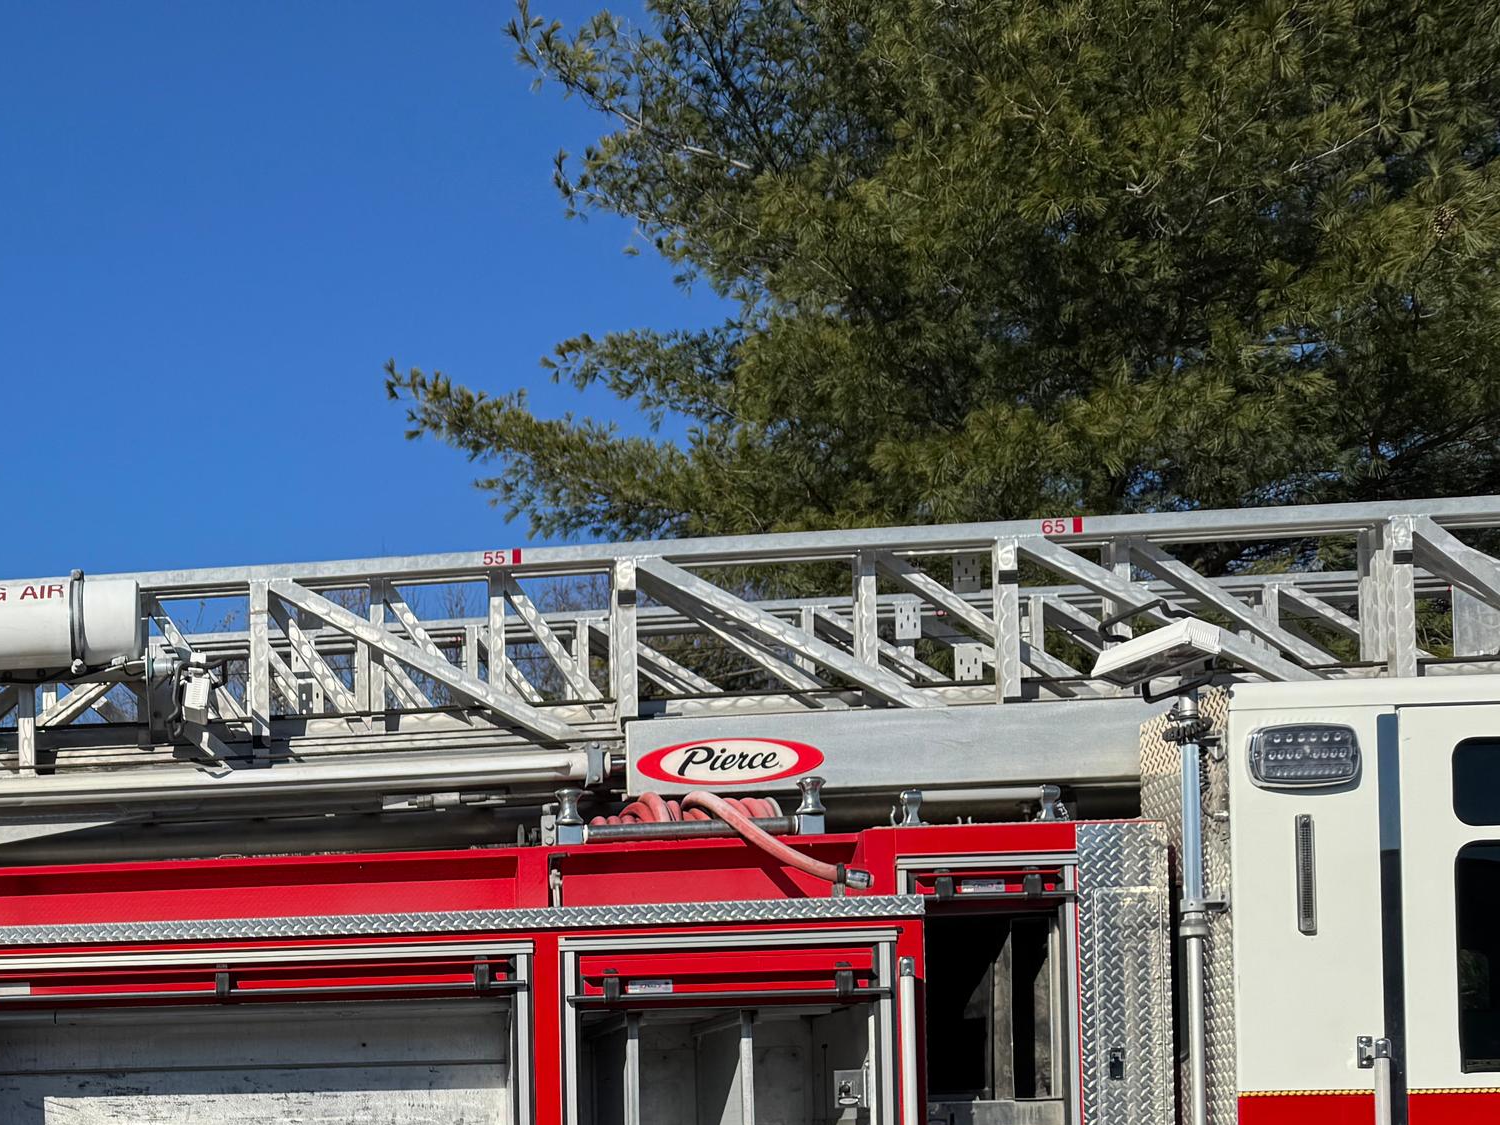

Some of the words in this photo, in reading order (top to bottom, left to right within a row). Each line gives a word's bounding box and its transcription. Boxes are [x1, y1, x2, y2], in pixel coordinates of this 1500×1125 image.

[1041, 519, 1066, 534] 65
[483, 550, 506, 565] 55
[19, 584, 65, 600] AIR
[677, 745, 780, 777] Pierce
